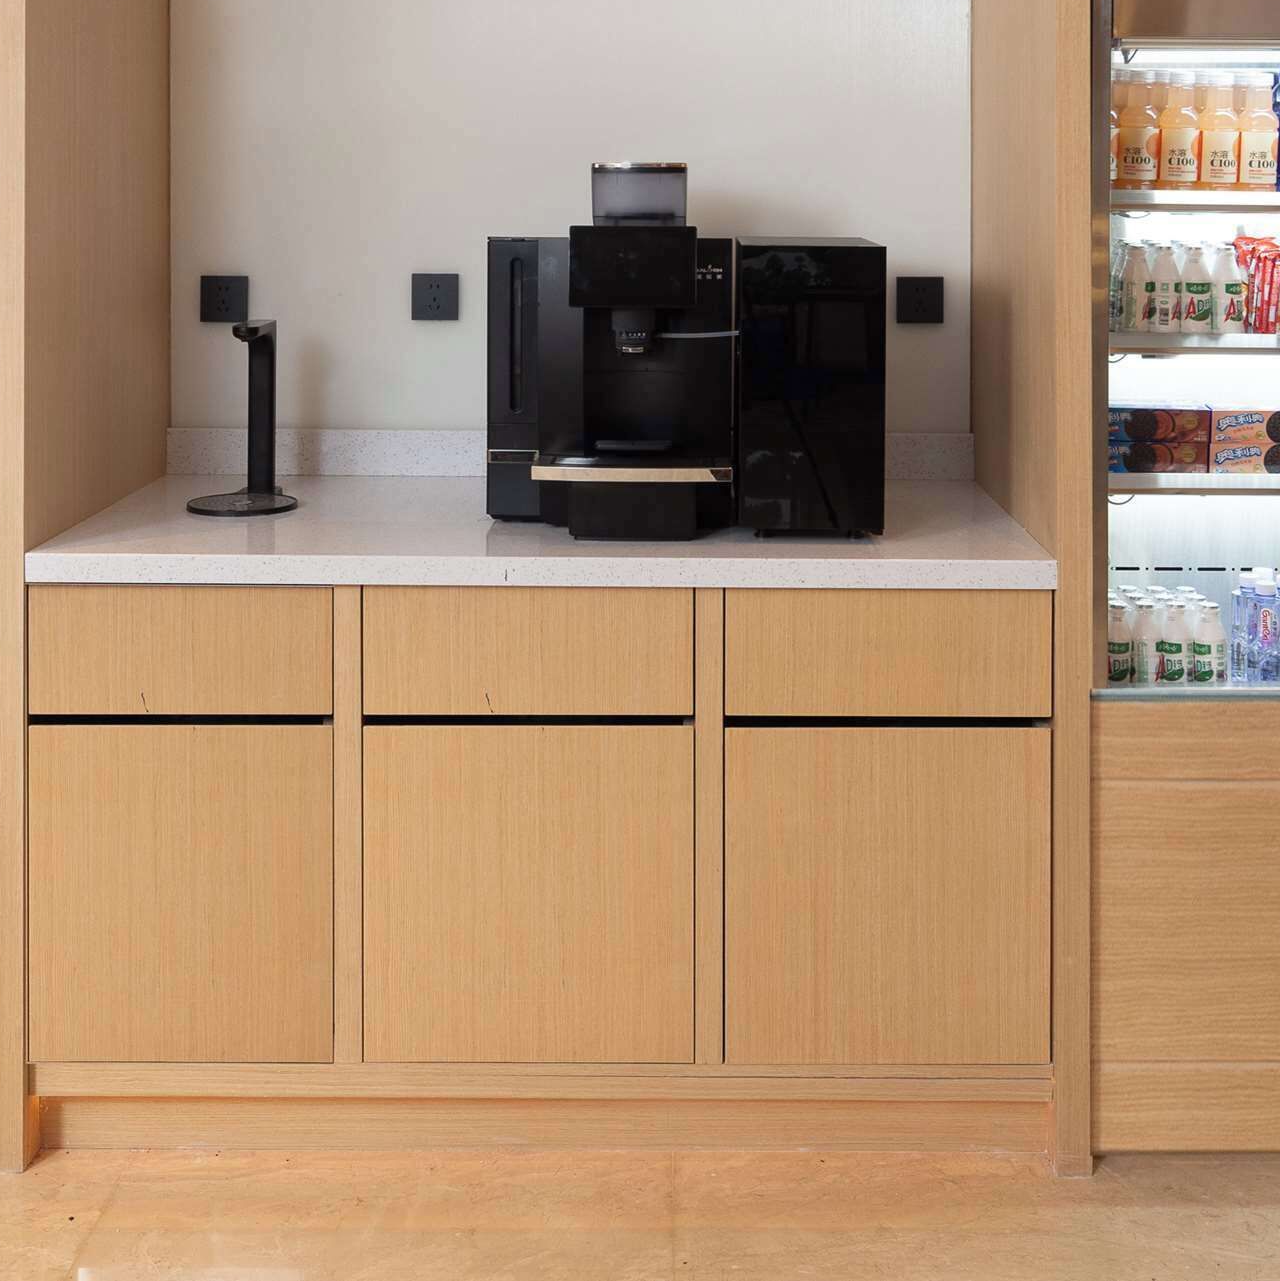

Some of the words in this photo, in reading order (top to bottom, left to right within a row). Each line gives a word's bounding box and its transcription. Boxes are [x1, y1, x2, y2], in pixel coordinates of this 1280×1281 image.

[1123, 155, 1152, 165] C100
[1167, 157, 1195, 167] C100
[1210, 159, 1236, 168] C100
[1248, 159, 1275, 169] C100
